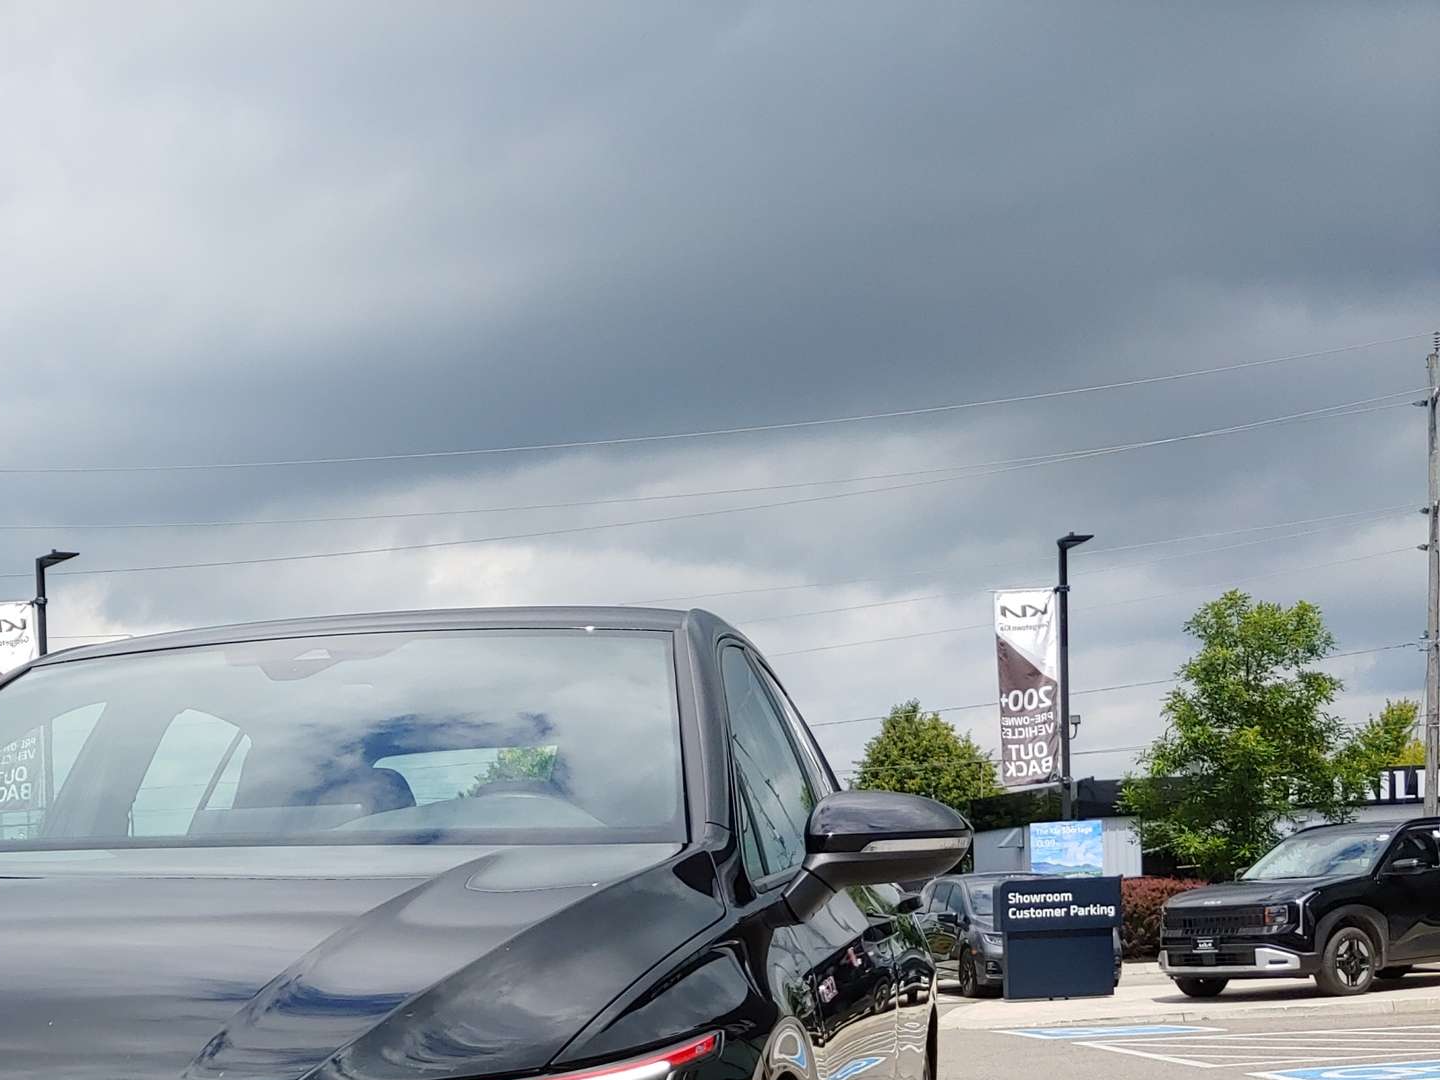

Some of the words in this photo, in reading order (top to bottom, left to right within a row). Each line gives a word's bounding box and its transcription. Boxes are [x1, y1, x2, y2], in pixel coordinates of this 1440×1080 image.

[1008, 891, 1073, 905] Showroom
[1008, 906, 1068, 919] Customer
[1070, 903, 1116, 917] Parking
